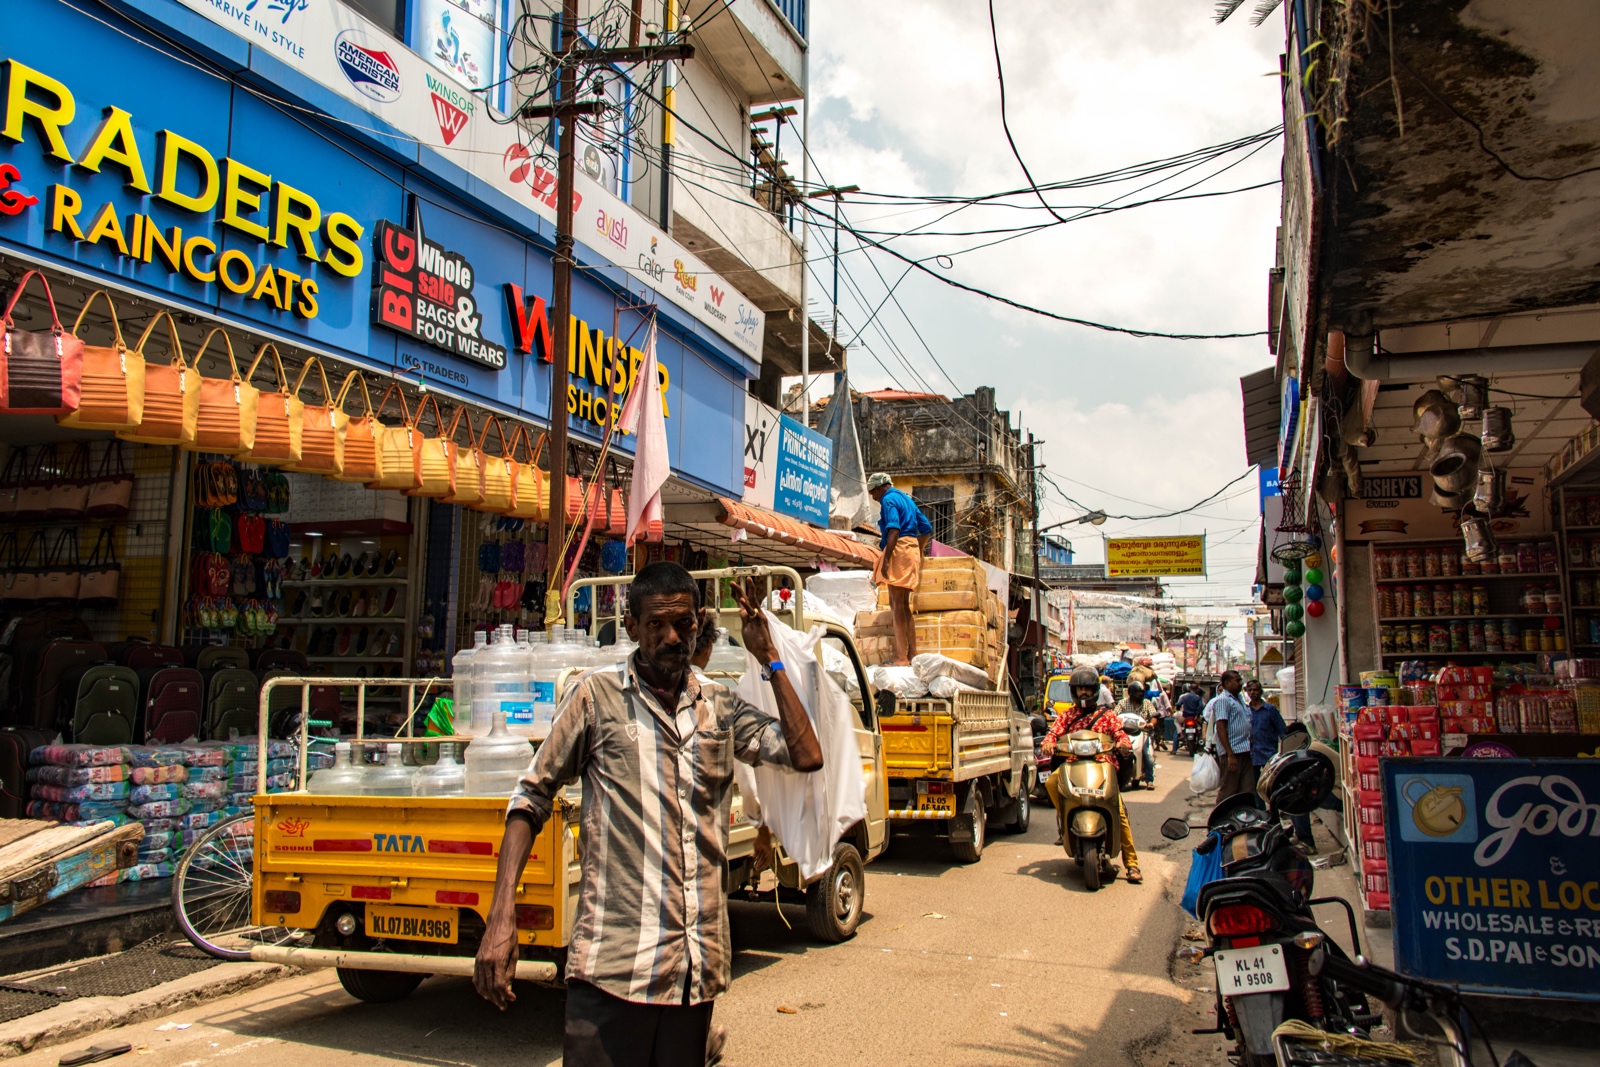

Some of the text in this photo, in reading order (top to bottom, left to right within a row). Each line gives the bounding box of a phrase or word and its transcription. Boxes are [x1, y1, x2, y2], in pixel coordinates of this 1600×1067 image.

[254, 20, 268, 37] IN
[271, 31, 305, 59] STYLE
[338, 40, 400, 84] AMERICAN
[338, 47, 400, 93] TOURISTER
[426, 73, 475, 117] WINSOR
[1, 58, 364, 278] RADERS
[49, 183, 320, 319] RAINCOATS
[417, 222, 472, 290] Whole
[638, 252, 666, 283] cater
[383, 227, 415, 331] BIG
[418, 271, 455, 307] sale
[674, 258, 698, 292] Real
[416, 296, 479, 339] BAGS &
[704, 301, 727, 324] WILDCRAFT
[416, 318, 504, 368] FOOT WEARS
[567, 383, 630, 436] SHOE
[782, 427, 830, 471] PRINCE STORES
[274, 844, 313, 852] SOUND
[374, 833, 426, 853] TATA
[1550, 856, 1568, 876] &
[1424, 875, 1531, 909] OTHER
[1422, 910, 1554, 936] WHOLESALE
[1233, 972, 1273, 987] H 9508
[1235, 957, 1265, 972] KL 41
